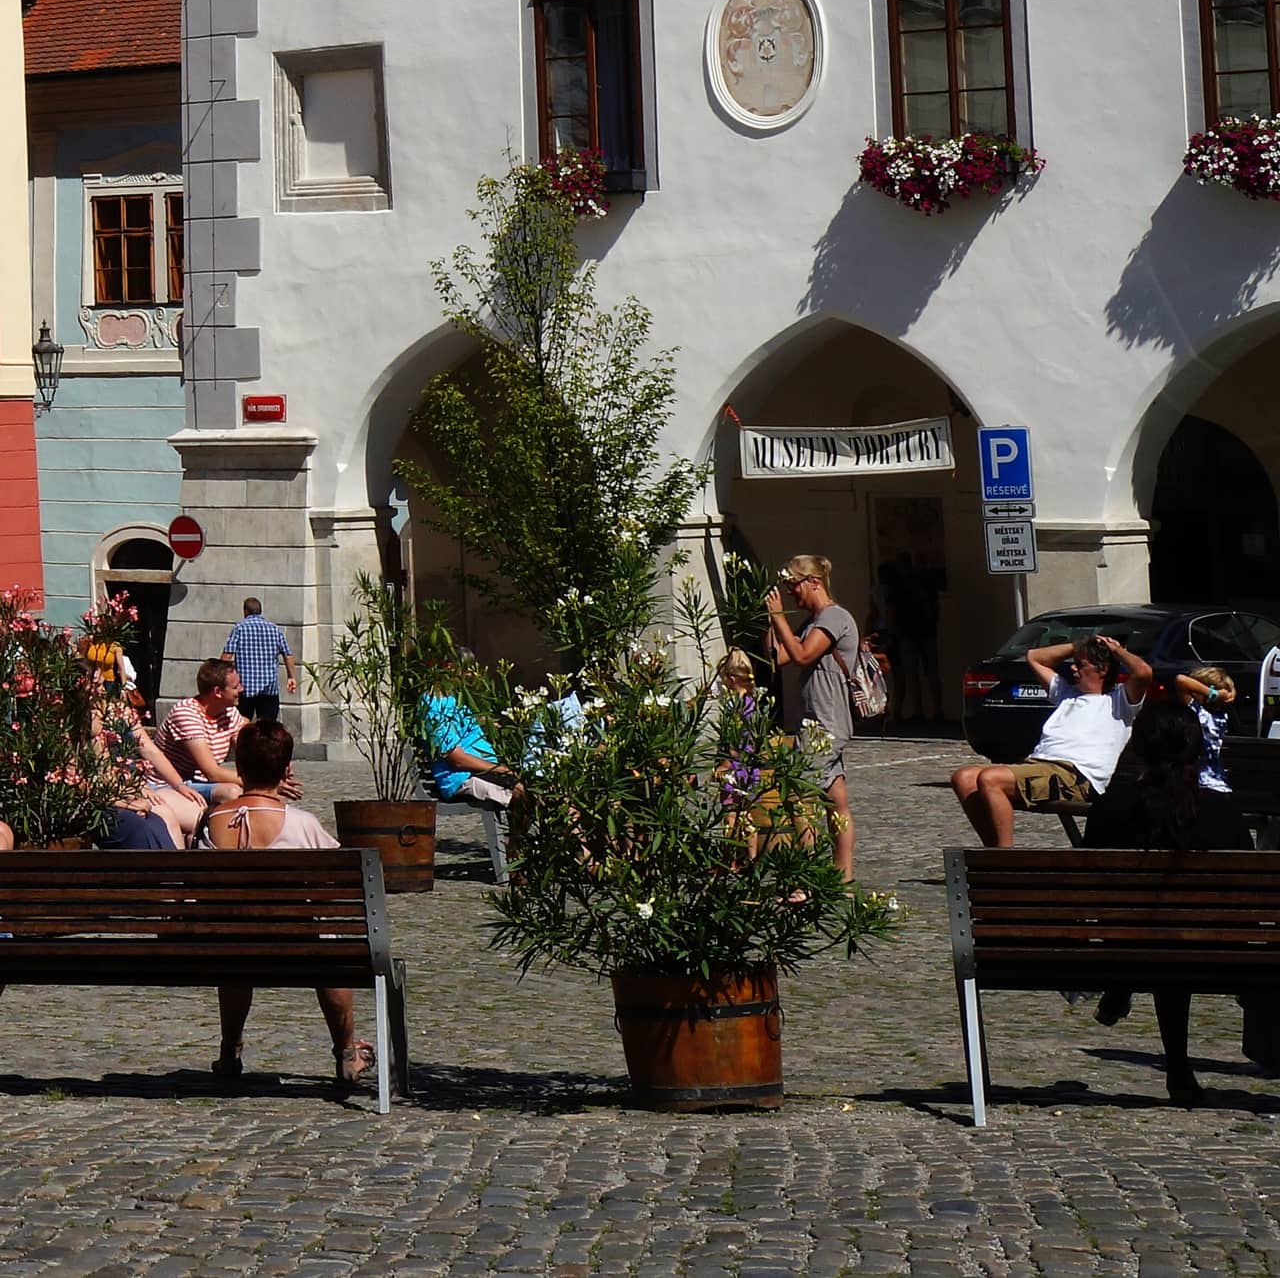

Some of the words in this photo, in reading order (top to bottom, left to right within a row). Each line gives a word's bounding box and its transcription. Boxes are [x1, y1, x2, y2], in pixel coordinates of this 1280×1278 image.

[753, 436, 839, 469] MUSEUM
[848, 426, 942, 467] TORTURY
[989, 437, 1019, 479] P
